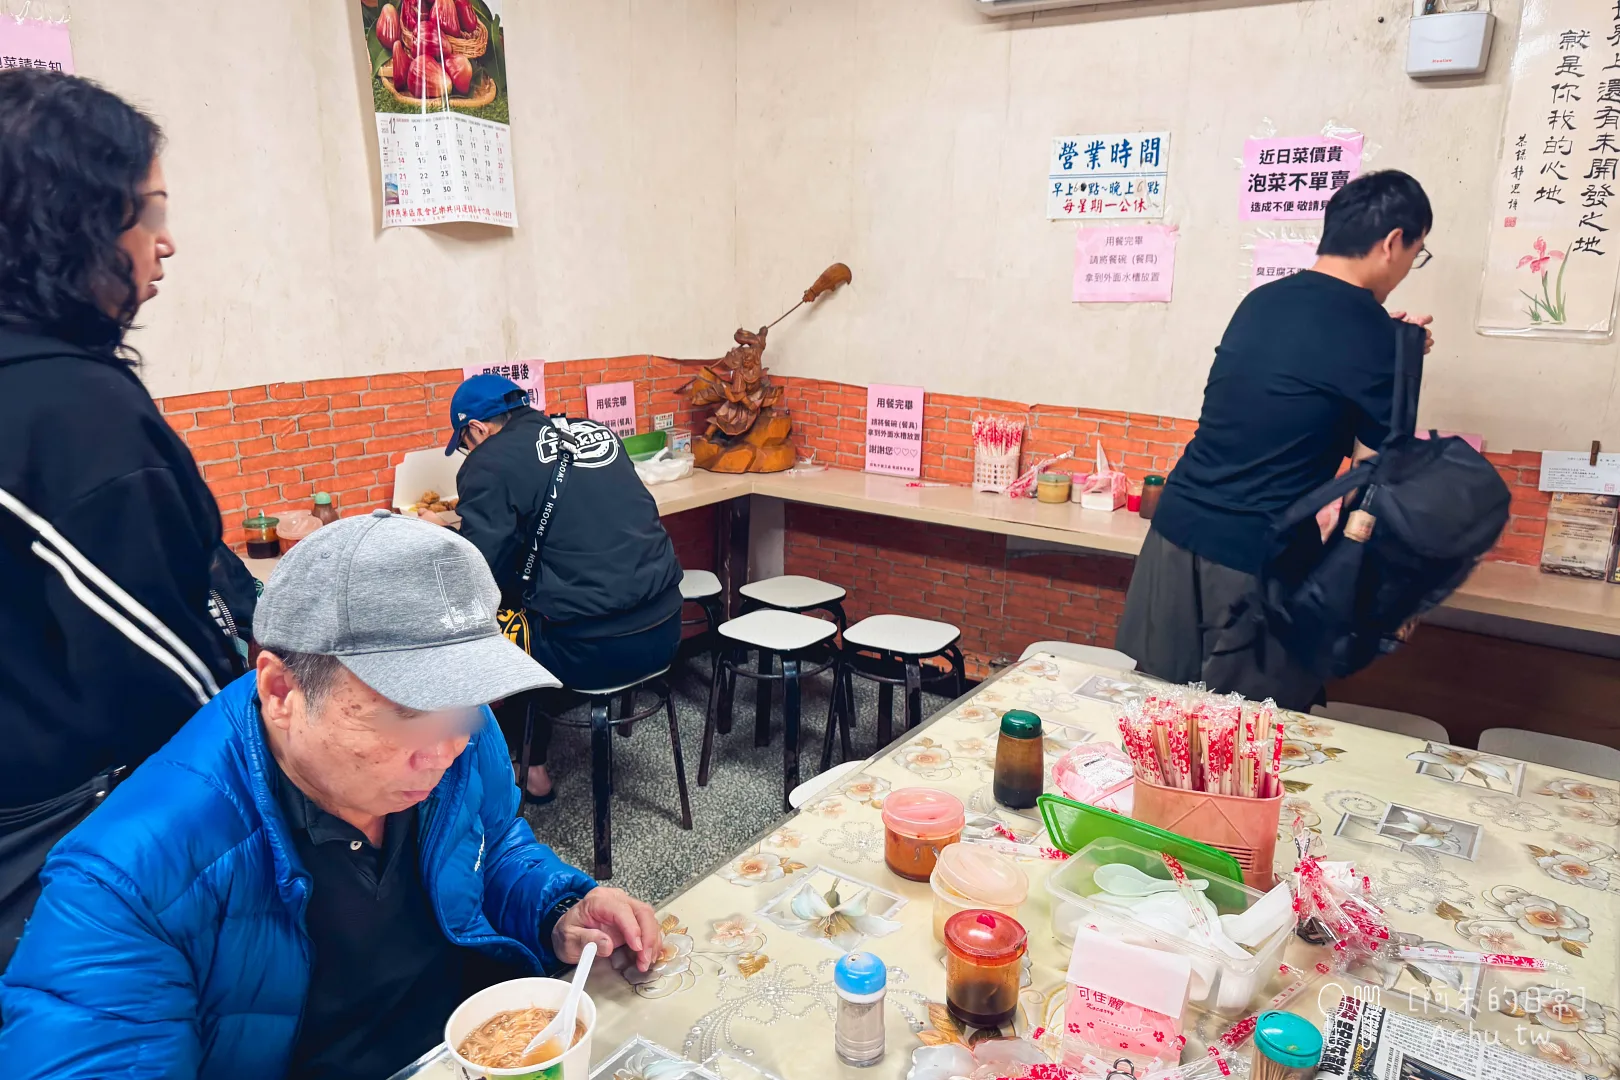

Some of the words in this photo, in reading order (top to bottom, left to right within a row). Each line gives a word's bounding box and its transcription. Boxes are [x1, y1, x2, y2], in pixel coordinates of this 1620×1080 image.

[1534, 29, 1591, 205] 就是你我的心地
[1059, 137, 1161, 170] 營業時間
[1259, 145, 1343, 164] 近日菜價貴
[1248, 170, 1350, 192] 泡菜不單賣
[1063, 198, 1147, 213] 每星期一公休
[1251, 201, 1294, 212] 造成不便
[1105, 236, 1143, 246] 用餐完畢
[1085, 272, 1160, 282] 拿到外面水槽放置
[1256, 267, 1304, 277] 臭豆腐不
[596, 396, 627, 410] 用餐完畢
[876, 398, 913, 410] 用餐完畢
[868, 429, 920, 441] 拿到外面水槽放置
[869, 445, 893, 456] 謝謝您
[537, 502, 554, 536] SWOOSH
[524, 553, 536, 575] OOSH
[1077, 985, 1125, 1011] 可佳麗
